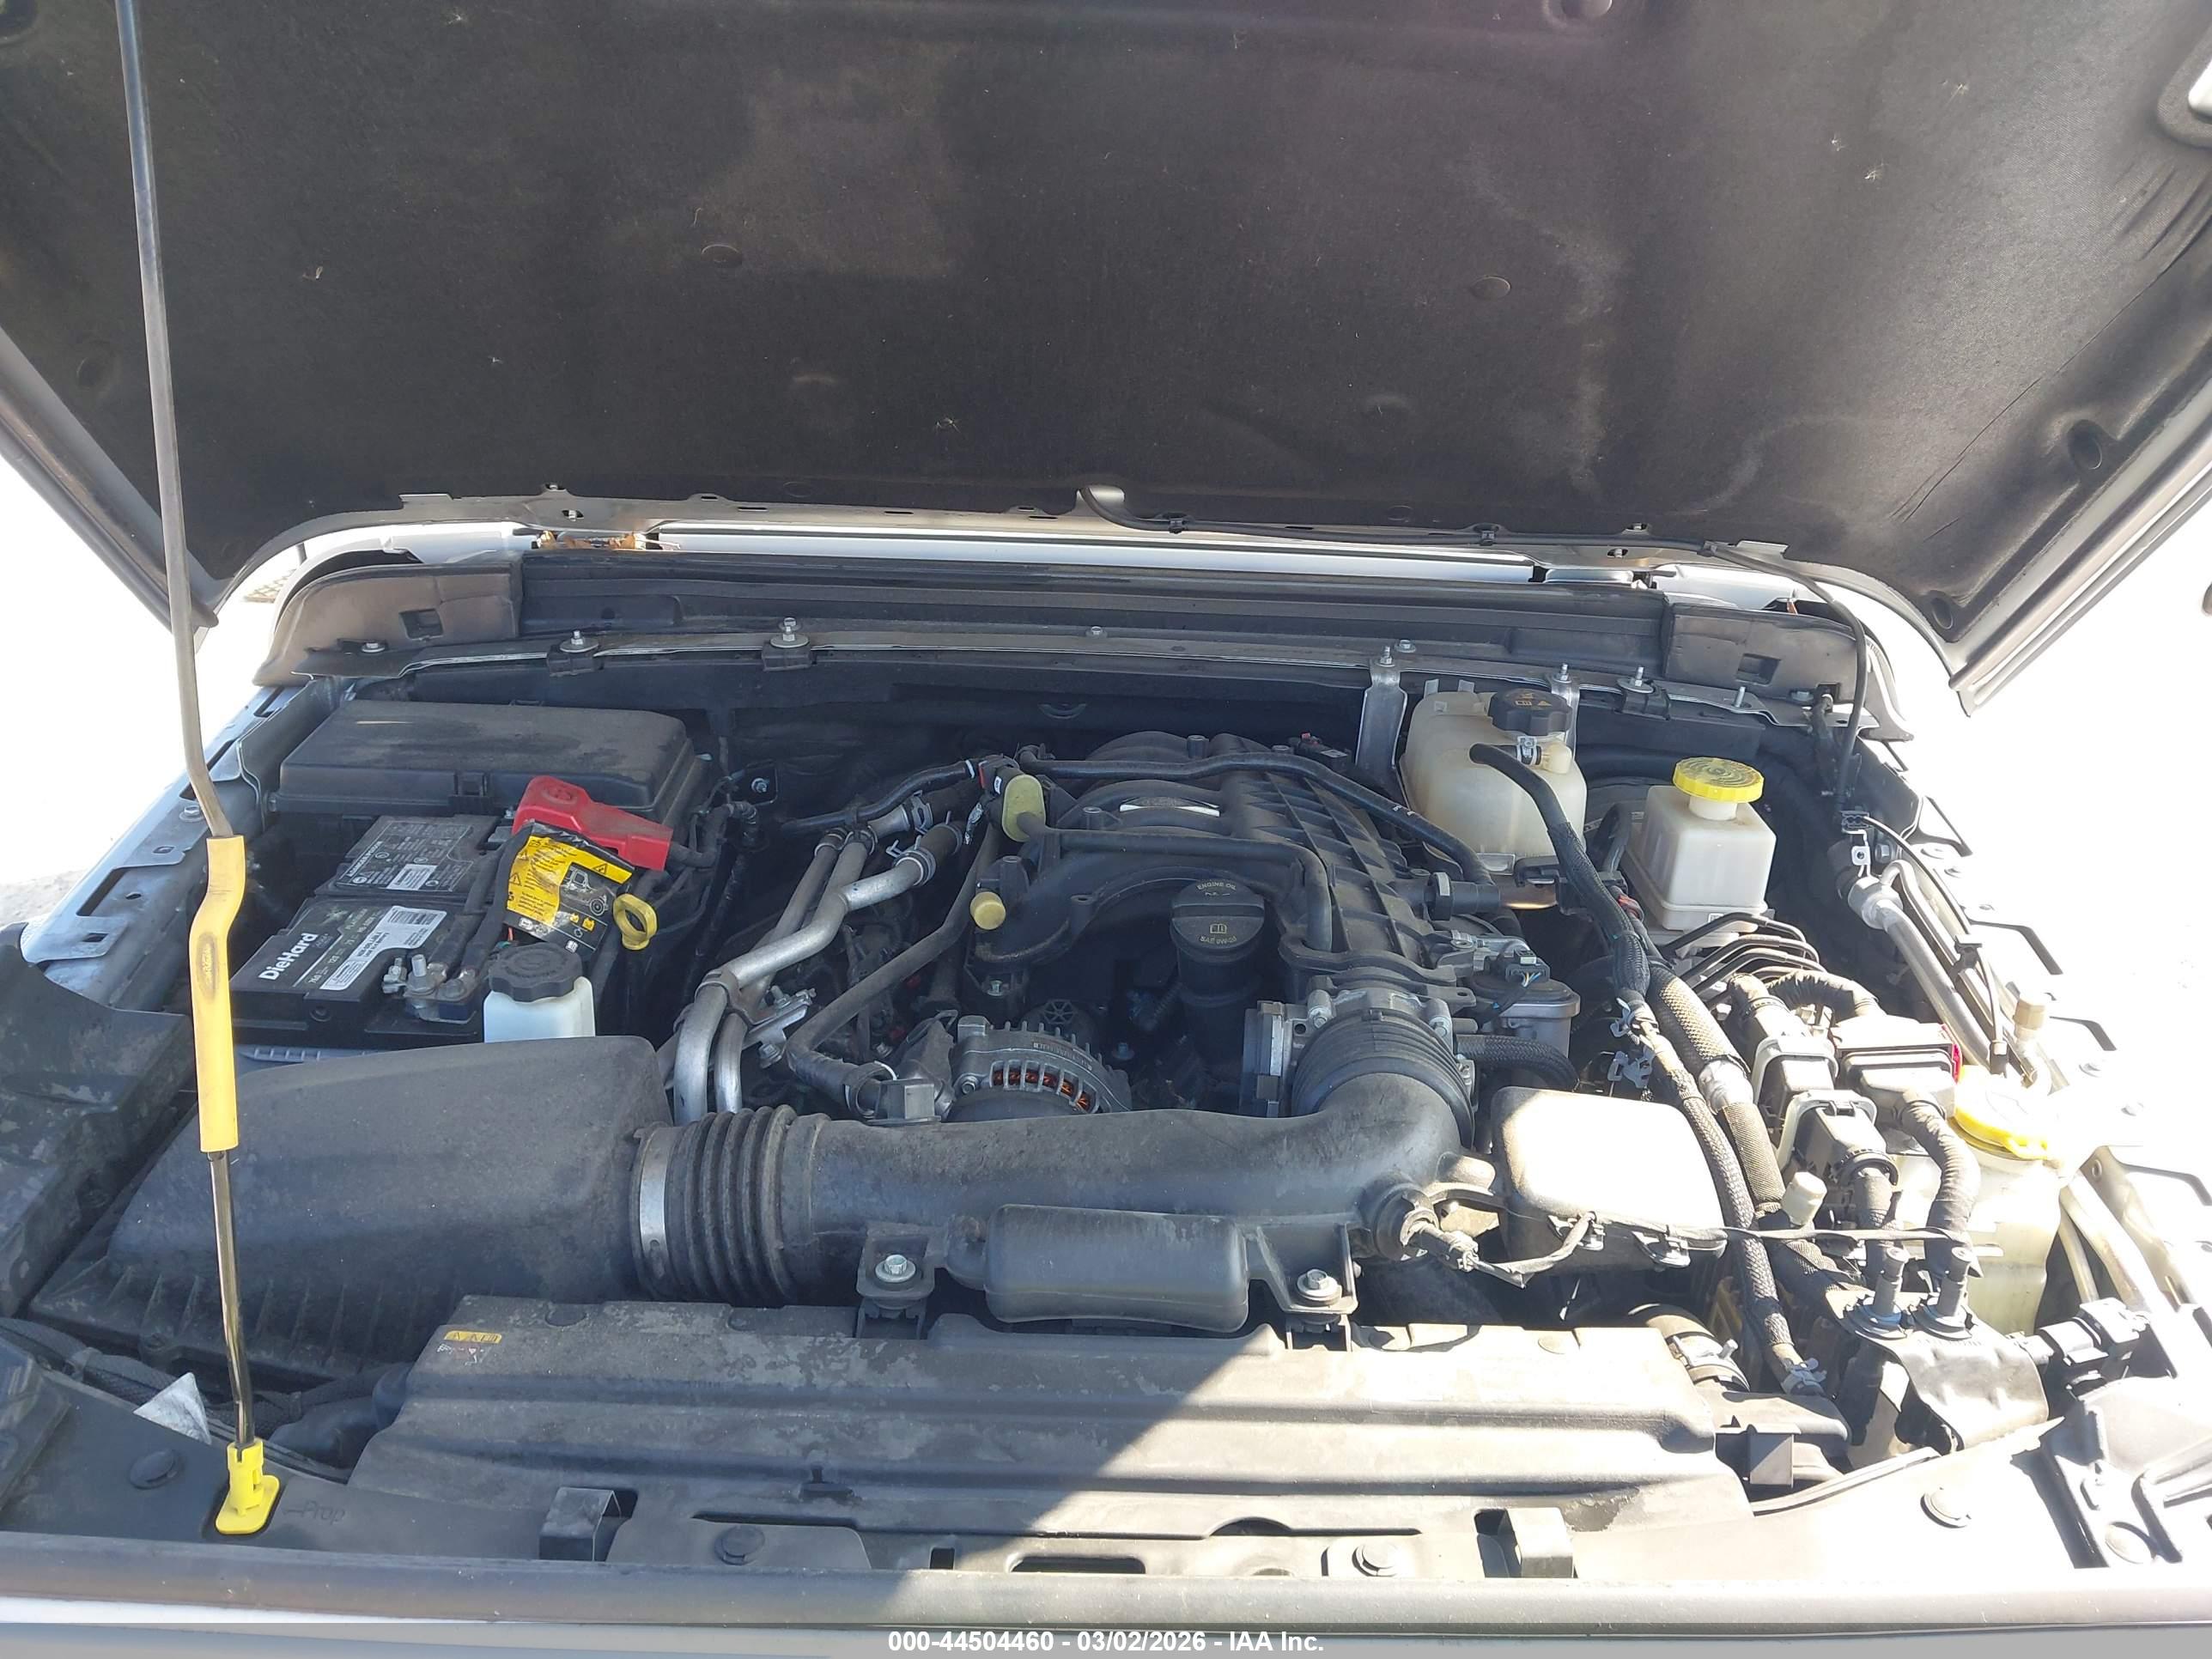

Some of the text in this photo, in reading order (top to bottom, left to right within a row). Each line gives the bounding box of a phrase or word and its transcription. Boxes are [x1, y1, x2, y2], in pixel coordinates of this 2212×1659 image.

[1196, 881, 1237, 891] ENGINE OIL
[1199, 935, 1215, 944] SAE
[258, 933, 319, 981] DieHard
[301, 1499, 346, 1526] Prop
